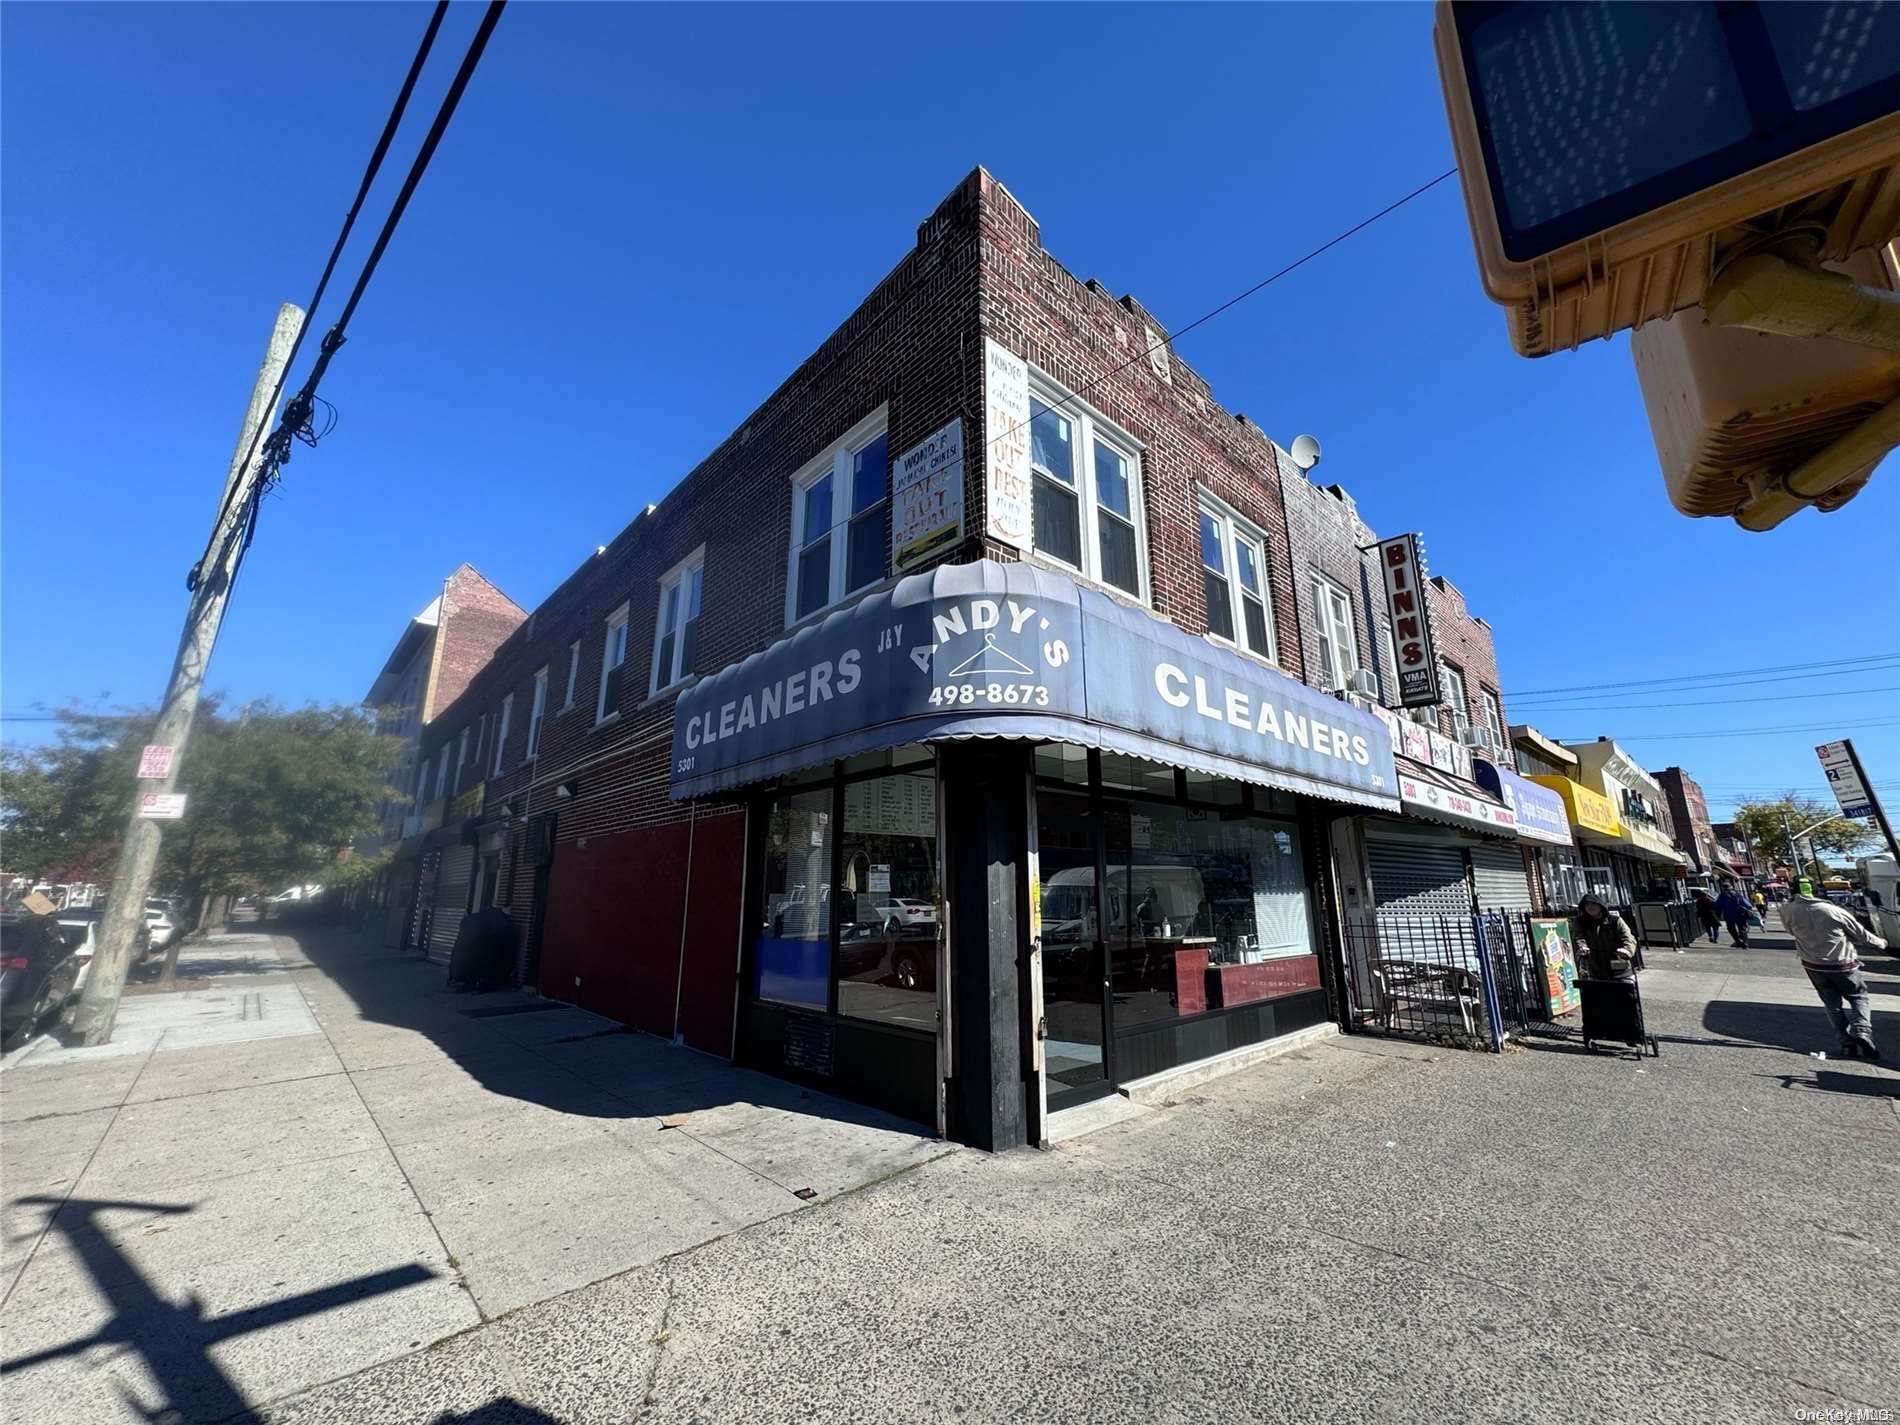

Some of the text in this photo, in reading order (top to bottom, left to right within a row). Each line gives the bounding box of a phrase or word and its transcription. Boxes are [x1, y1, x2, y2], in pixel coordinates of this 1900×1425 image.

[1386, 543, 1423, 666] BINNS
[877, 624, 903, 654] J&Y
[909, 600, 1071, 674] ANDY'S
[685, 649, 862, 750] CLEANERS
[928, 683, 1050, 706] 498-8673
[1403, 671, 1428, 684] VMA
[1154, 662, 1370, 766] CLEANERS
[677, 756, 695, 773] 5301
